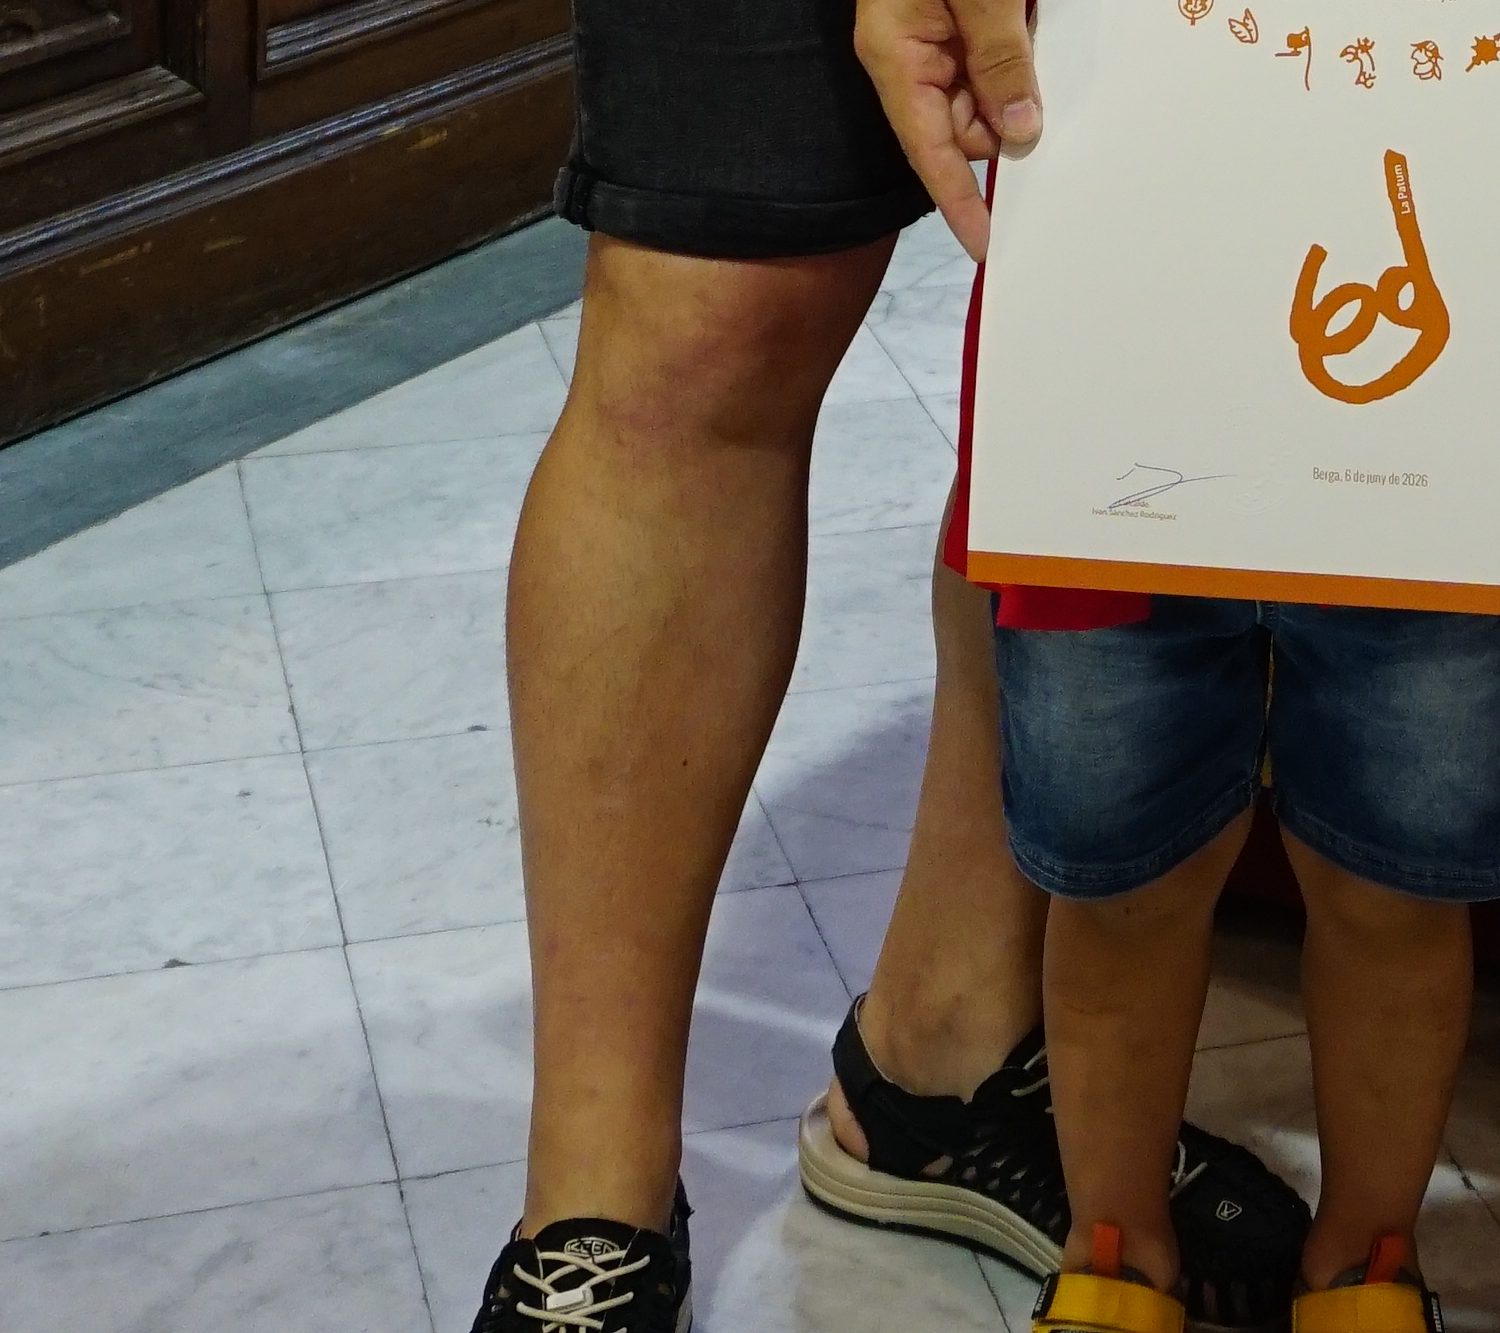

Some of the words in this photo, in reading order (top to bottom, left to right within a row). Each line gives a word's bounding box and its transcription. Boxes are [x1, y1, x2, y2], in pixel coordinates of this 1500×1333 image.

[1394, 164, 1408, 199] Patum
[1401, 201, 1411, 214] La
[1313, 466, 1343, 483] Berga,
[1345, 469, 1352, 481] 6
[1353, 469, 1366, 482] de
[1366, 472, 1386, 485] juny
[1388, 472, 1400, 485] de
[1401, 472, 1428, 487] 2026
